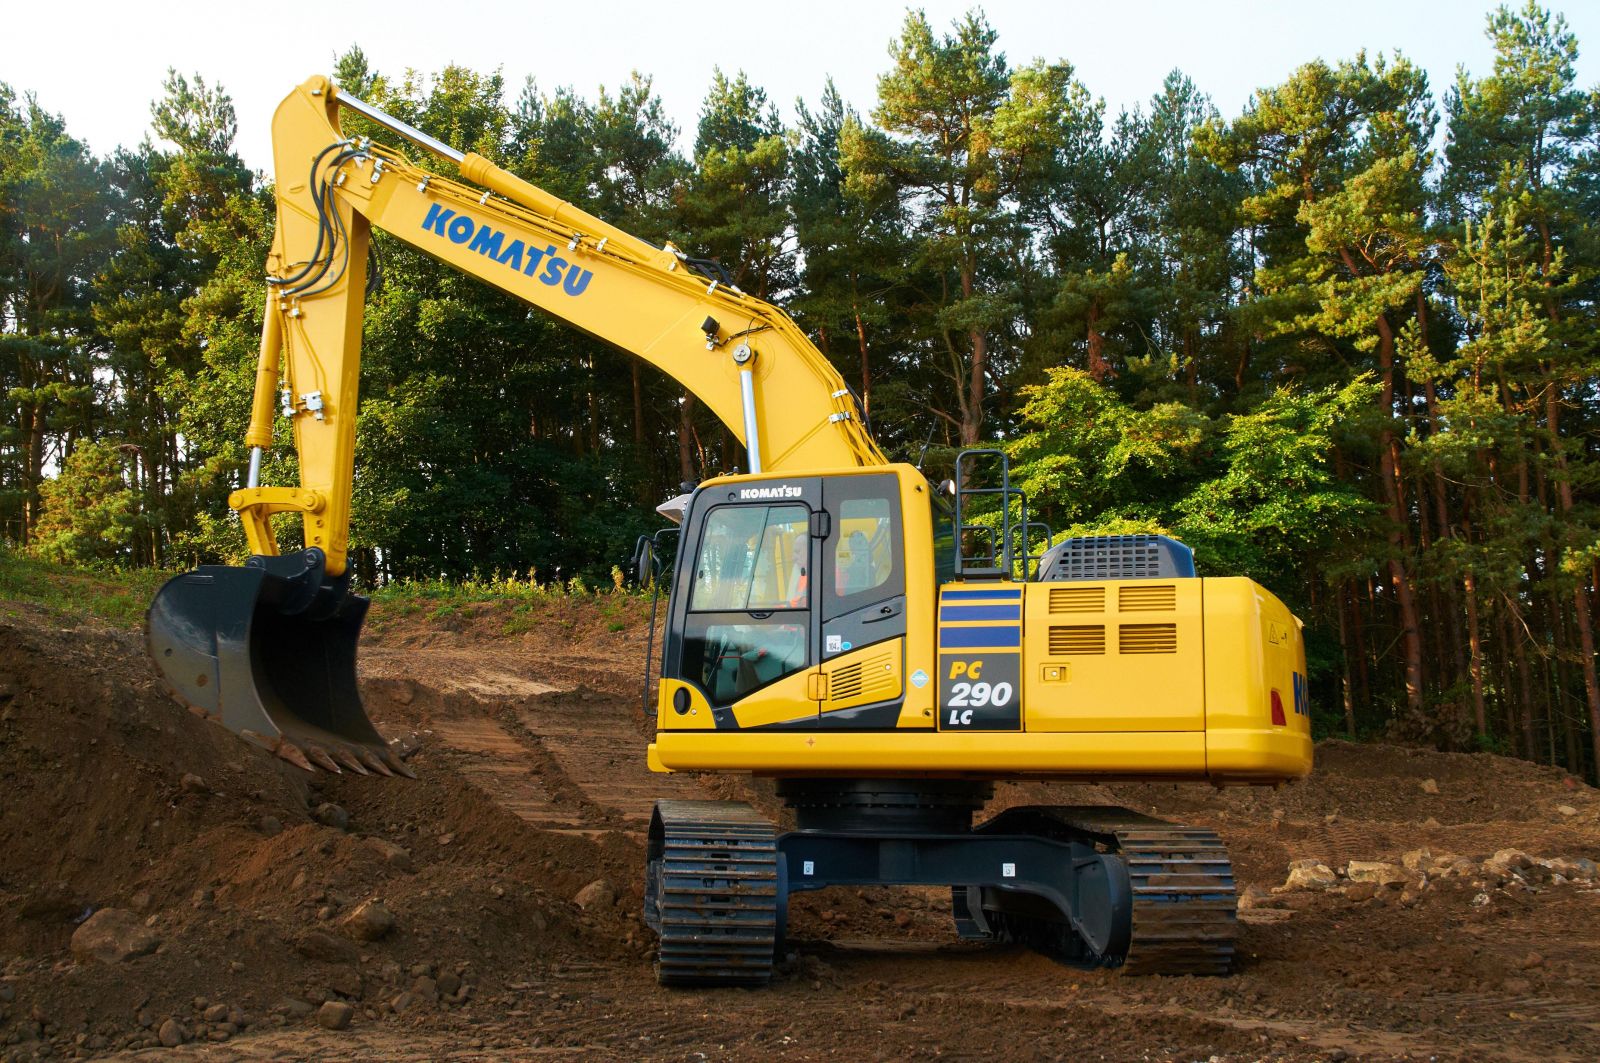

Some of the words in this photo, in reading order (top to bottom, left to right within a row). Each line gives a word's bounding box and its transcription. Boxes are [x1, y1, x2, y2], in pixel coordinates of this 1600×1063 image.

[421, 203, 594, 297] KOMATSU
[740, 485, 802, 499] KOMATSU
[948, 661, 983, 680] PC
[947, 682, 1013, 707] 290
[948, 709, 974, 725] LC
